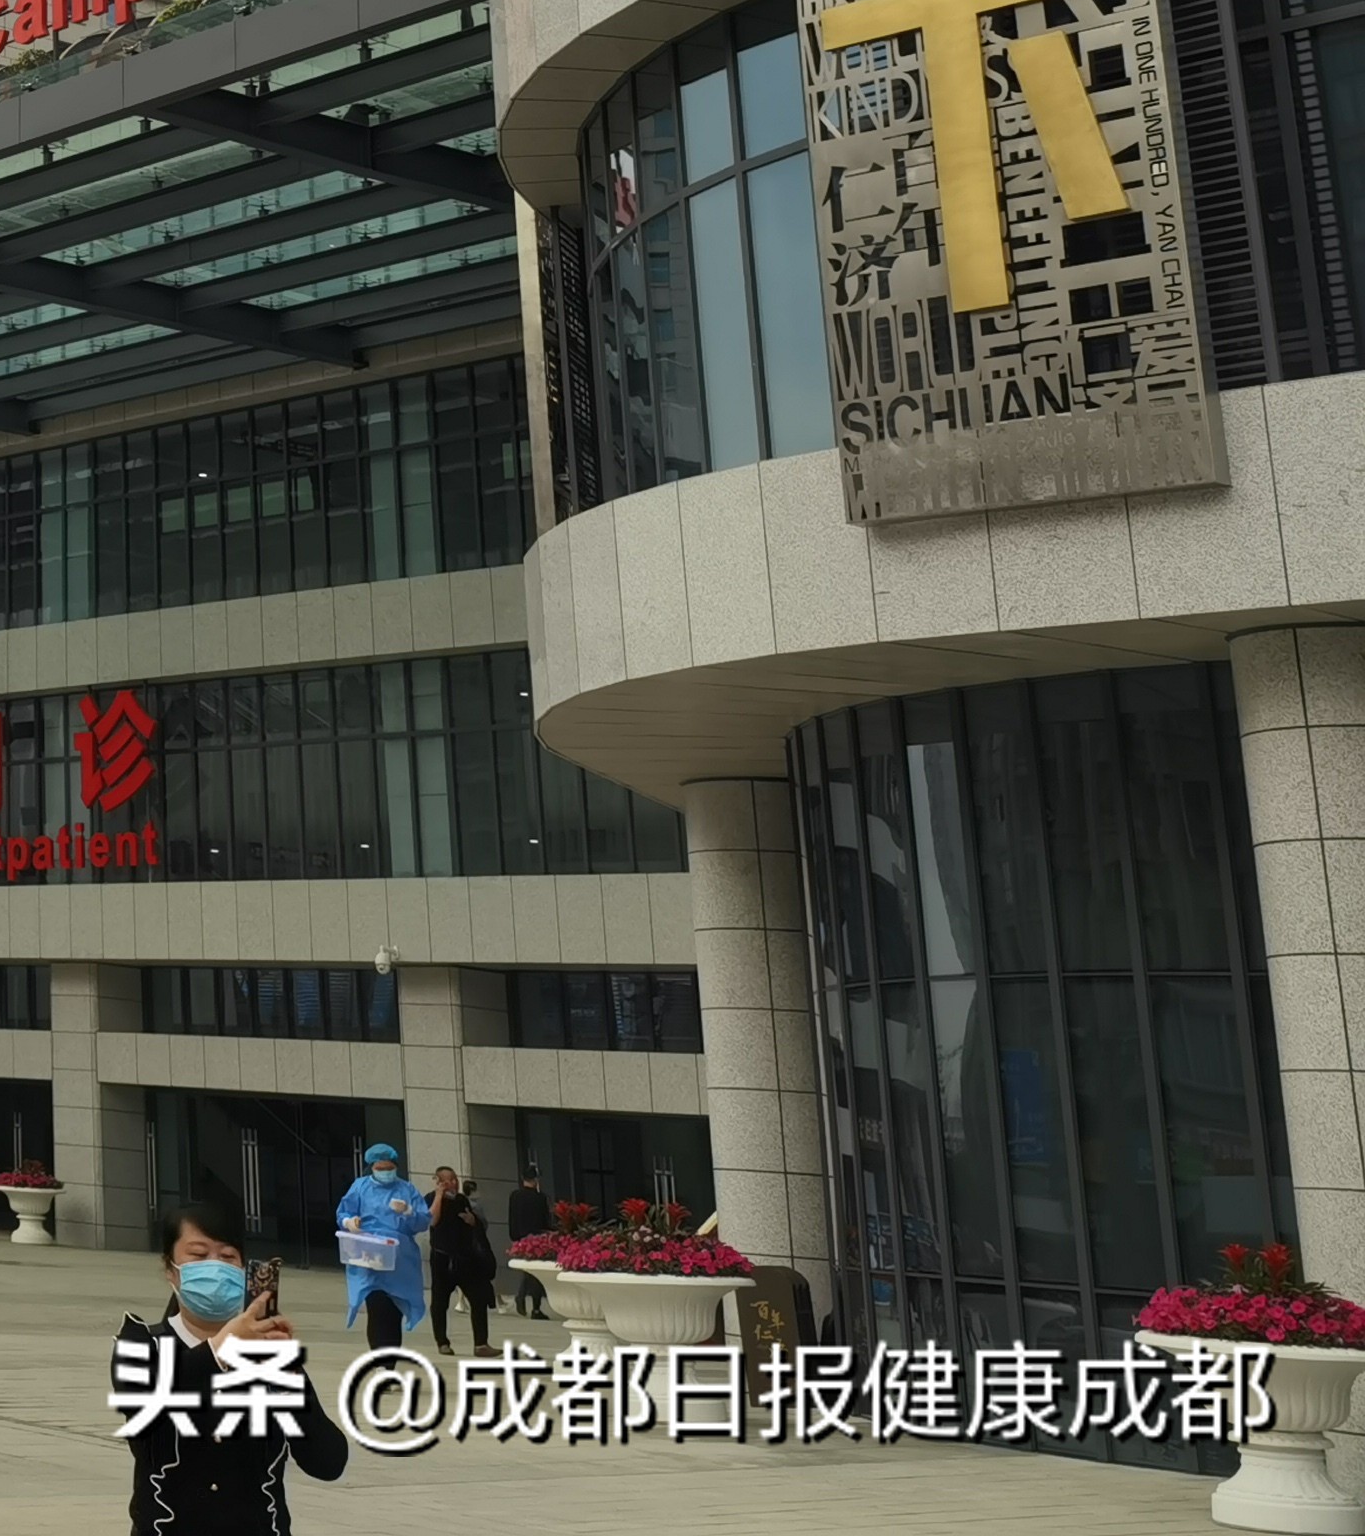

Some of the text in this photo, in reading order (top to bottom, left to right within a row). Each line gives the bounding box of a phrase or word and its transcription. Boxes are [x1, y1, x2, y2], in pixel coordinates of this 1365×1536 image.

[1135, 40, 1158, 84] ONE
[1155, 204, 1179, 252] YAN
[822, 162, 898, 306] 仁济
[841, 372, 1070, 454] SICHUAN
